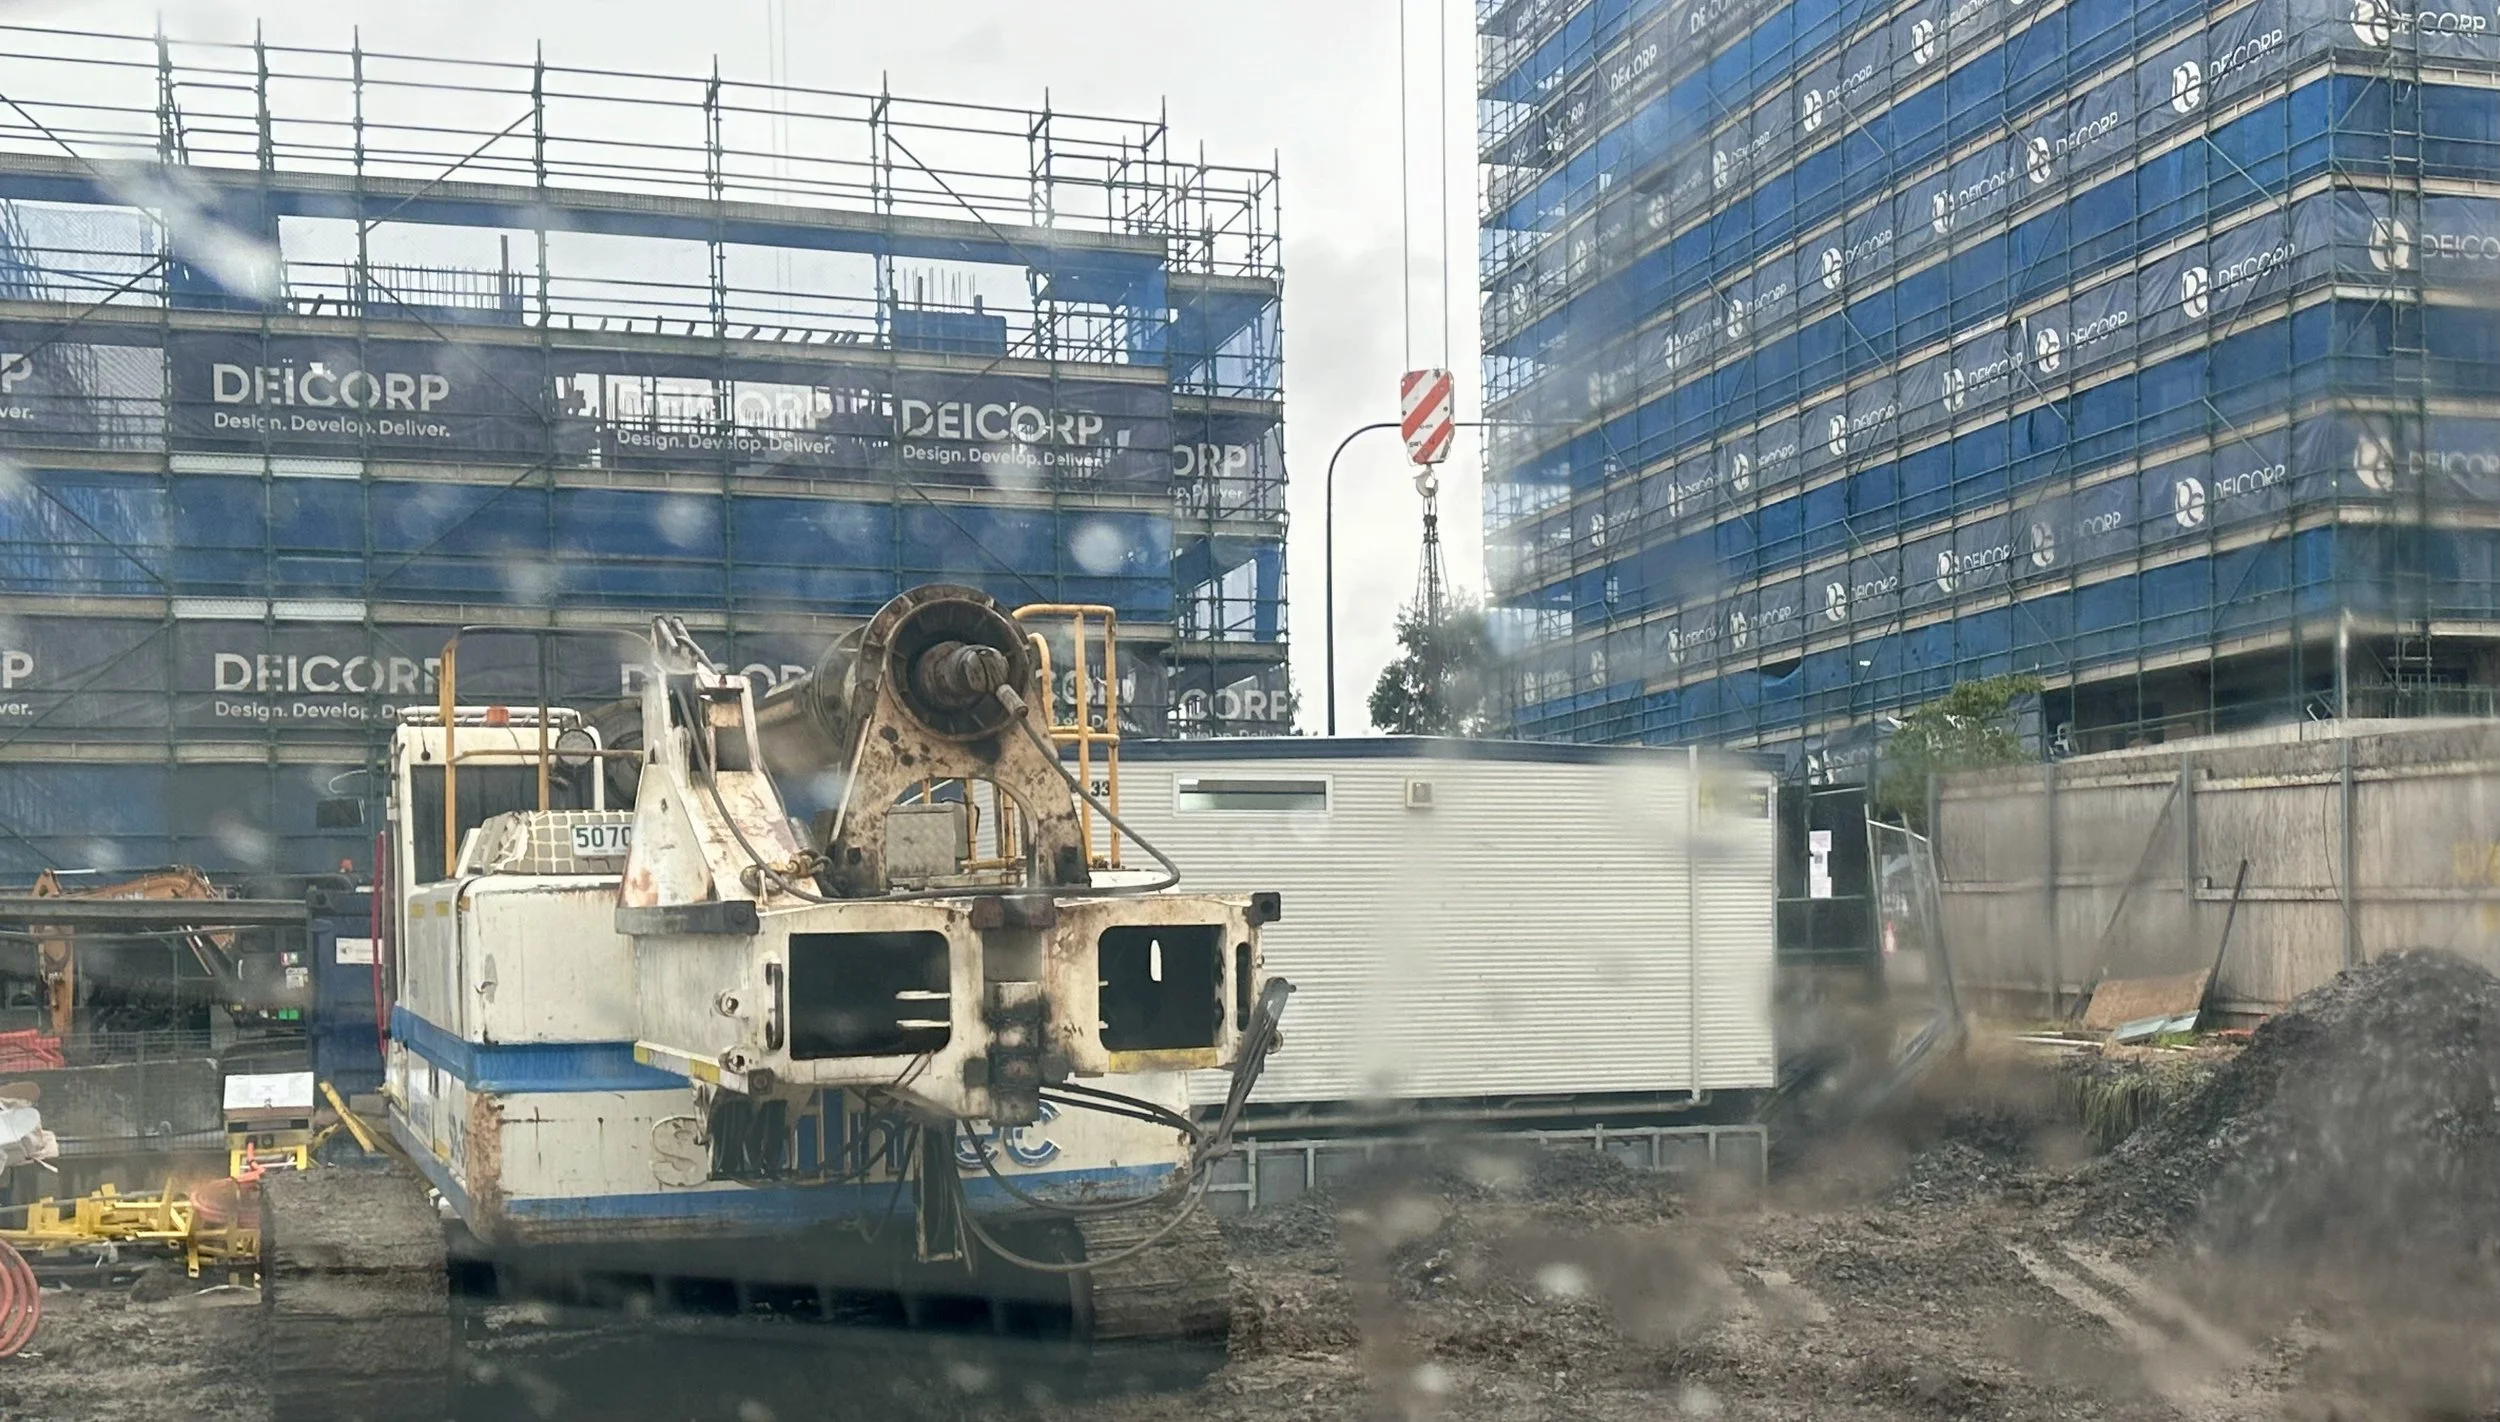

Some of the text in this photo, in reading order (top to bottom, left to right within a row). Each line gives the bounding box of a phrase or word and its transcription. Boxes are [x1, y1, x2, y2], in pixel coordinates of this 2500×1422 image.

[213, 362, 450, 411] DEICORP
[214, 412, 450, 437] Design. Develop. Deliver.
[902, 399, 1103, 445] DEICORP
[617, 429, 684, 450] Design.
[769, 437, 835, 454] Deliver.
[903, 444, 965, 464] Design.
[969, 448, 1041, 468] Develop.
[215, 701, 288, 721] Design.
